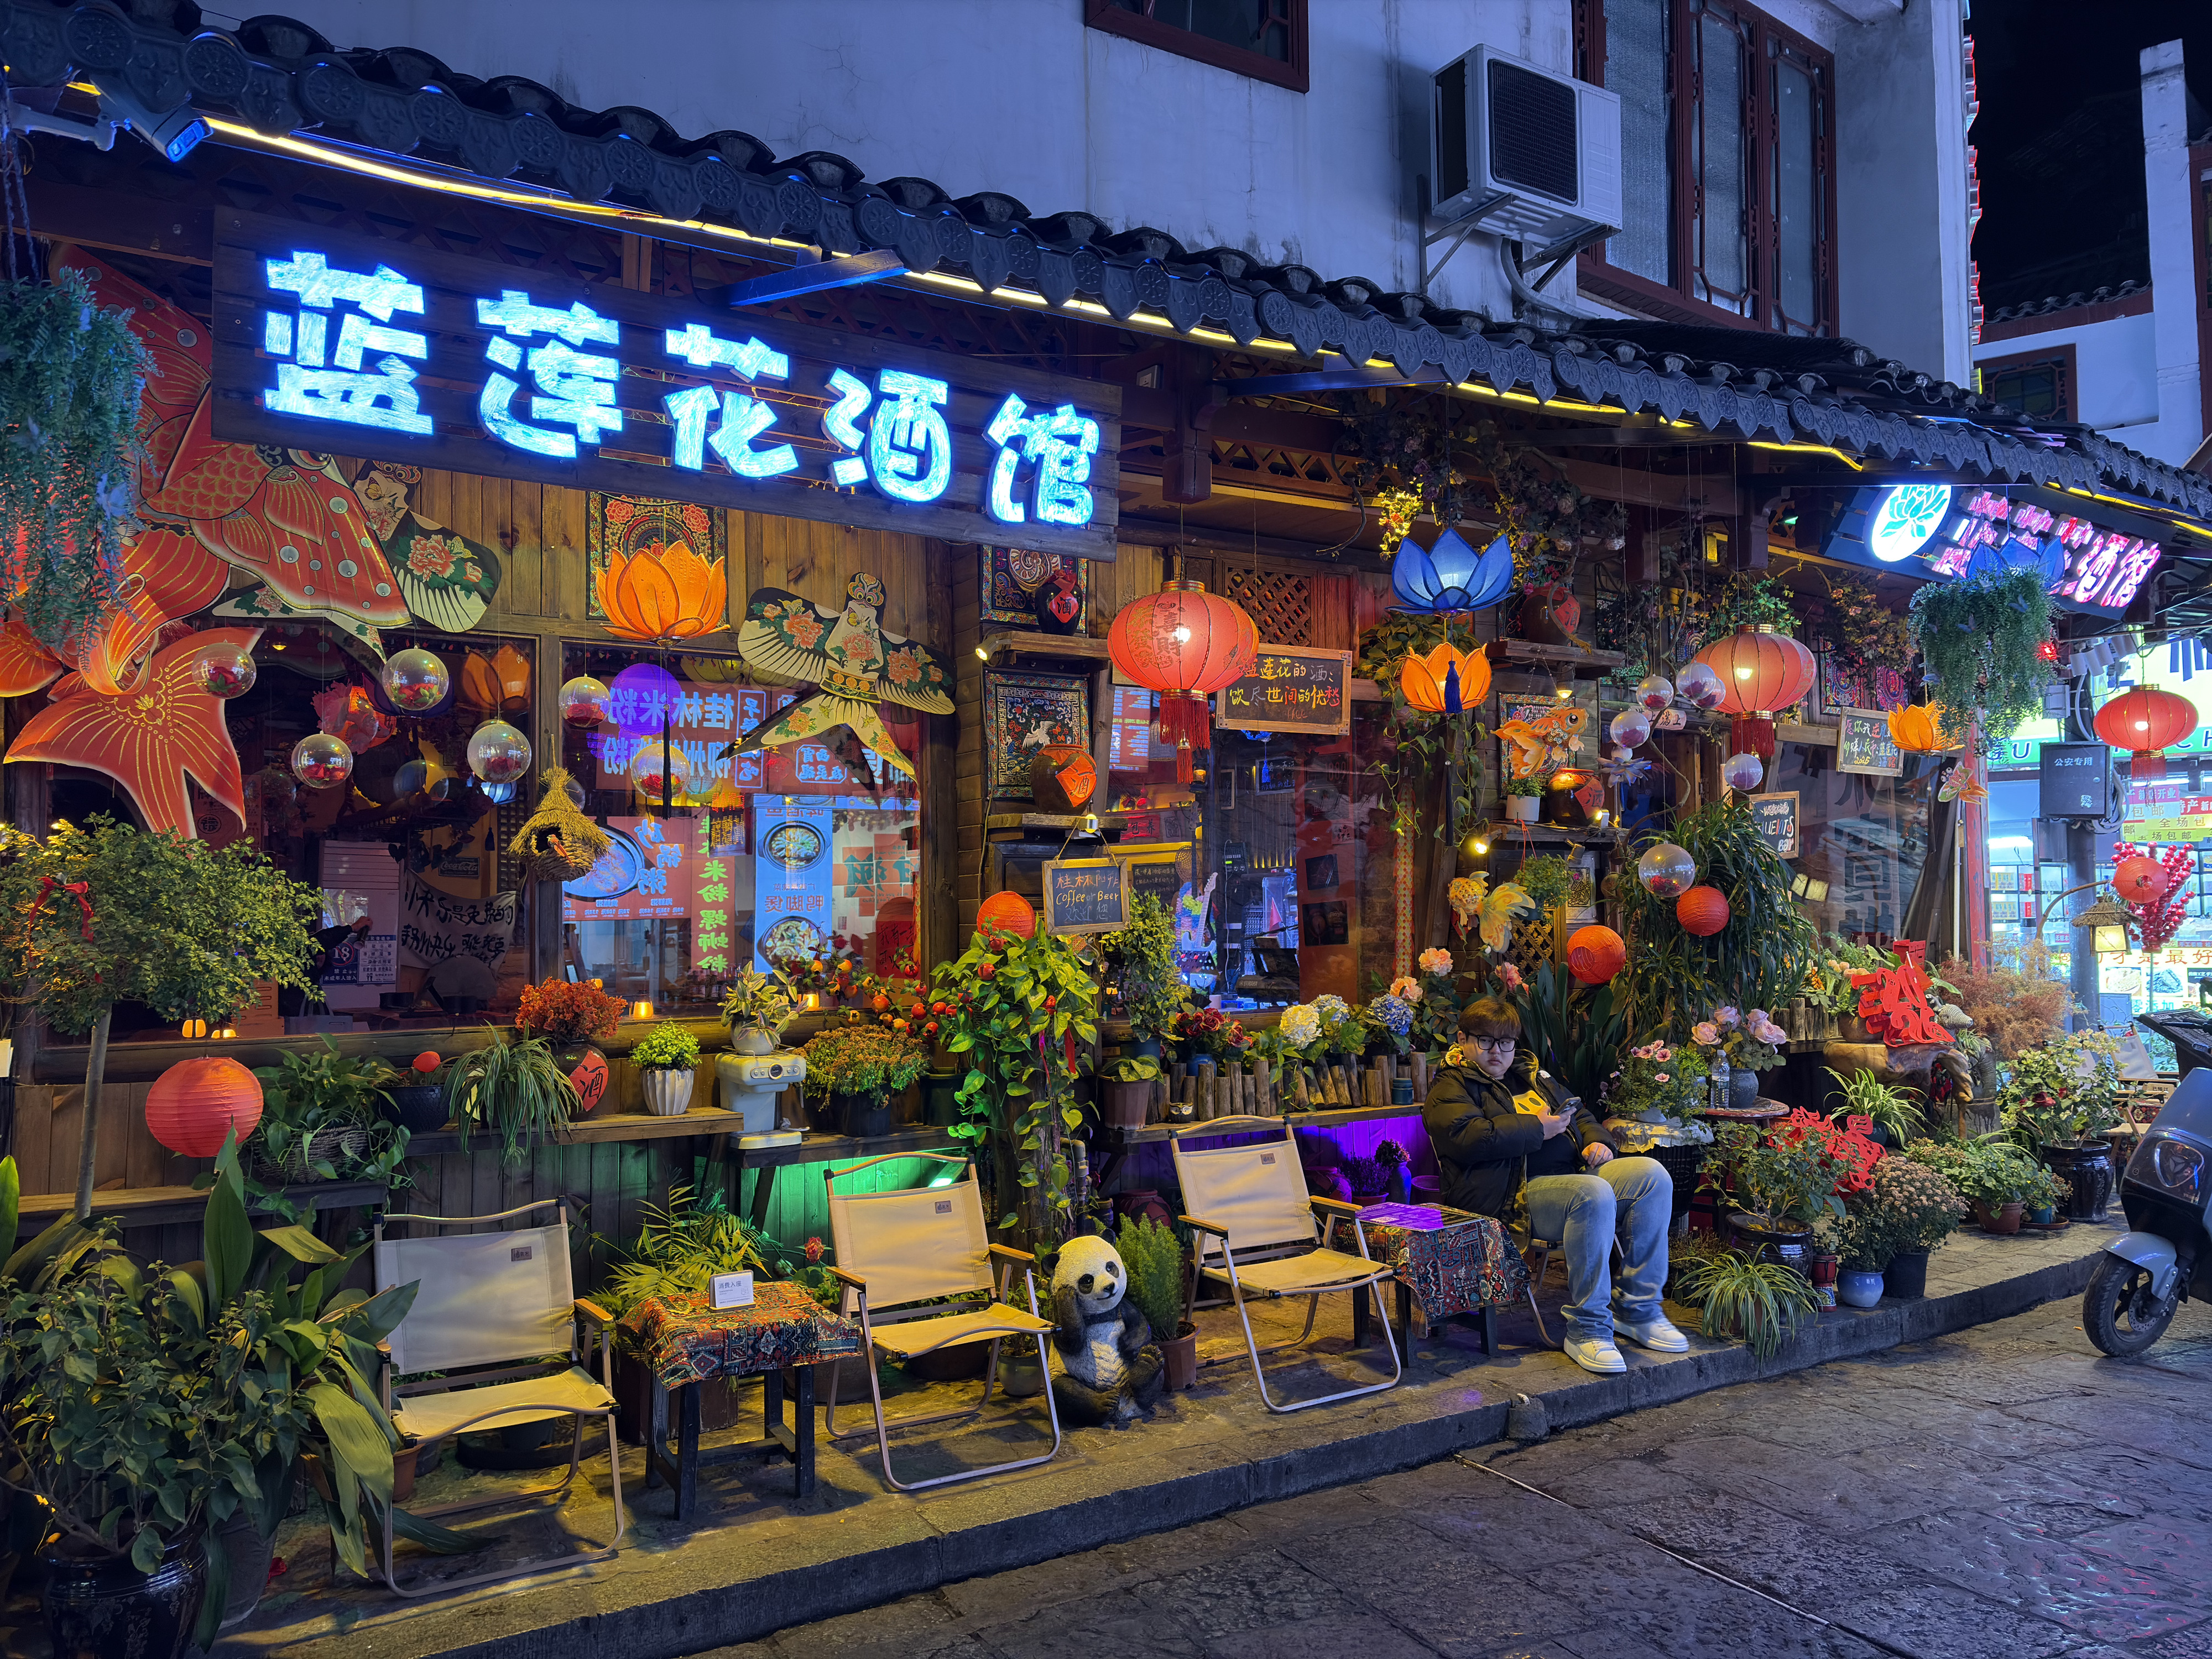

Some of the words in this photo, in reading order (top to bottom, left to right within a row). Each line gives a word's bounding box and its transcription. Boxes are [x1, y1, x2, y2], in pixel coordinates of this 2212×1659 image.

[264, 250, 1101, 525] 蓝莲花酒馆
[1057, 597, 1072, 616] 酒
[1635, 708, 1681, 726] 上满上
[2054, 757, 2094, 767] 公安专用
[1071, 766, 1093, 796] 酒
[1586, 787, 1604, 807] 酒
[2132, 805, 2164, 818] 包邮
[1056, 889, 1086, 908] Coffee
[1097, 890, 1119, 902] Beer
[580, 1065, 607, 1100] 酒
[717, 1280, 742, 1290] 消费入座
